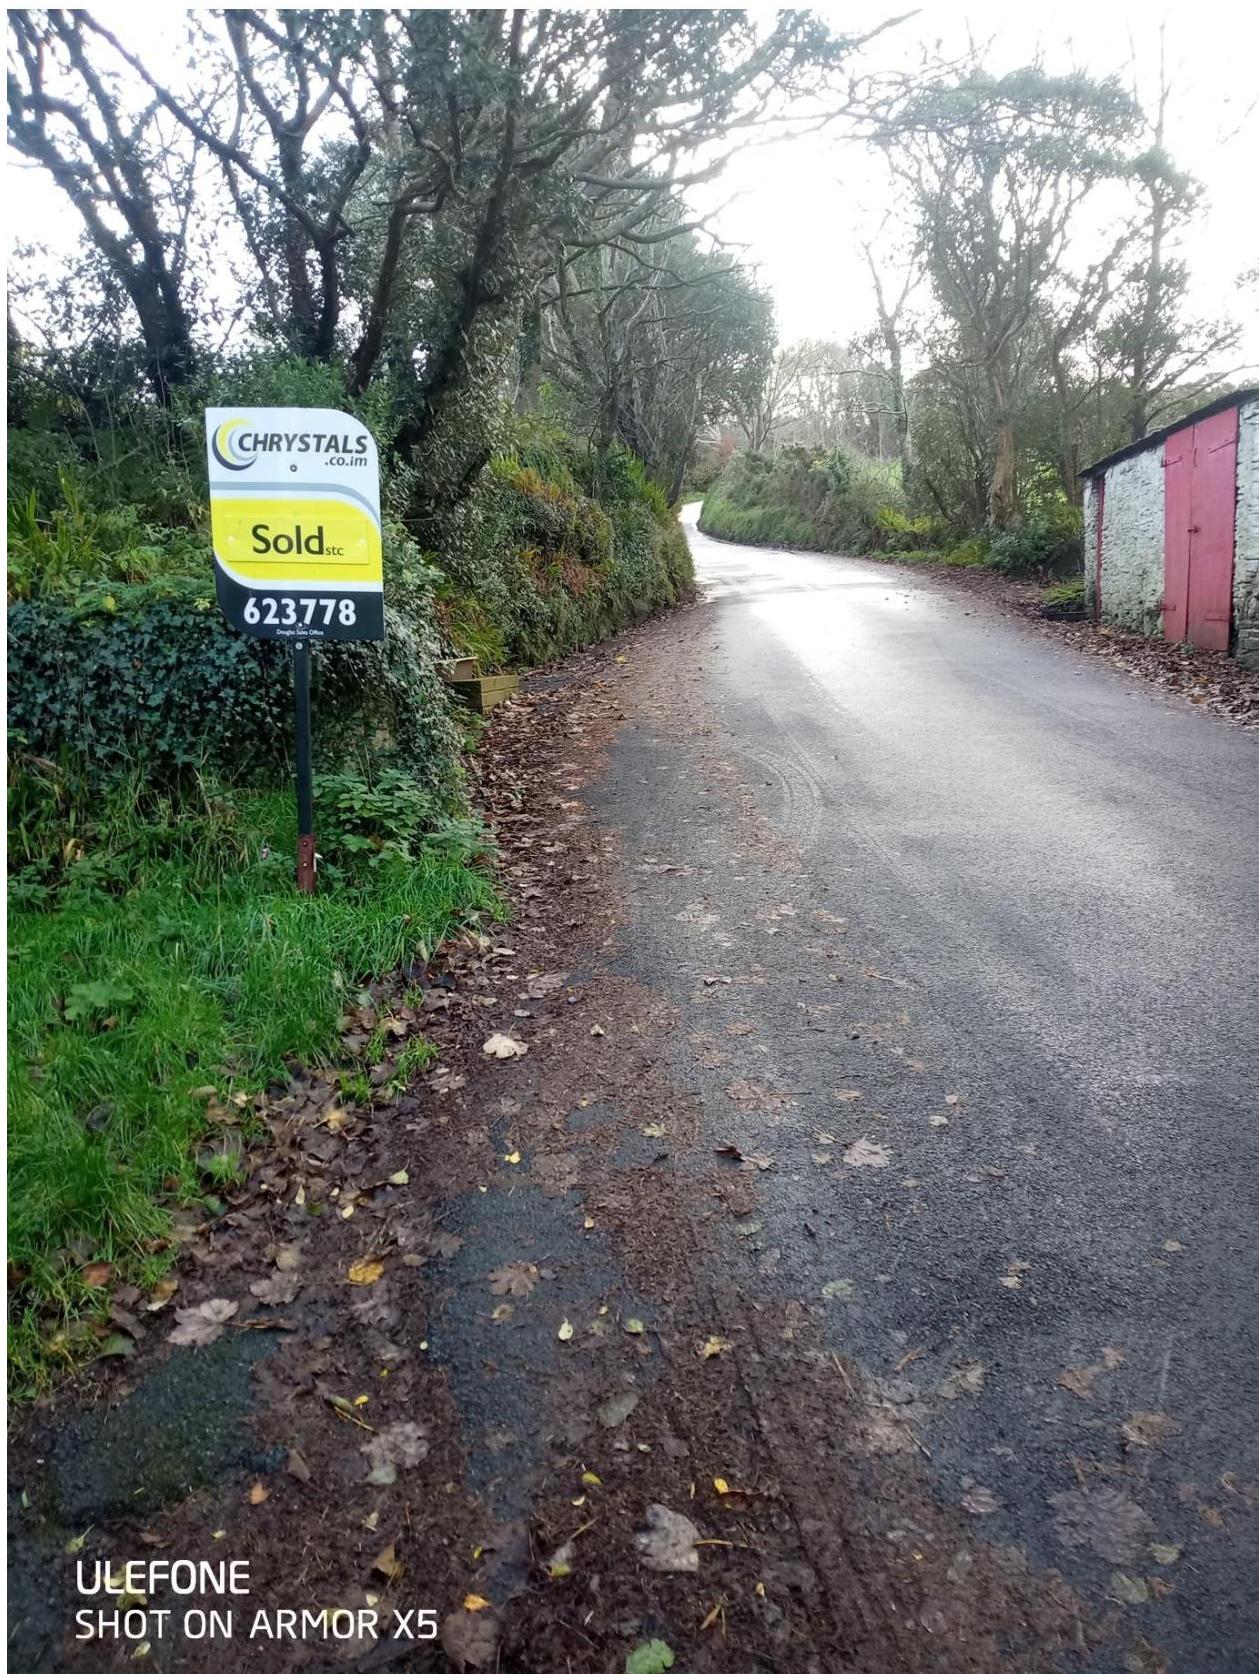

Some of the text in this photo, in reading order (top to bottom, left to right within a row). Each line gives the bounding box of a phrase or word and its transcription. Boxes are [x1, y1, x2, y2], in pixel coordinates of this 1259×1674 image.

[238, 432, 368, 454] CHRYSTALS
[325, 456, 368, 467] .co.im
[251, 524, 344, 556] Sold stc
[243, 597, 357, 626] 623778
